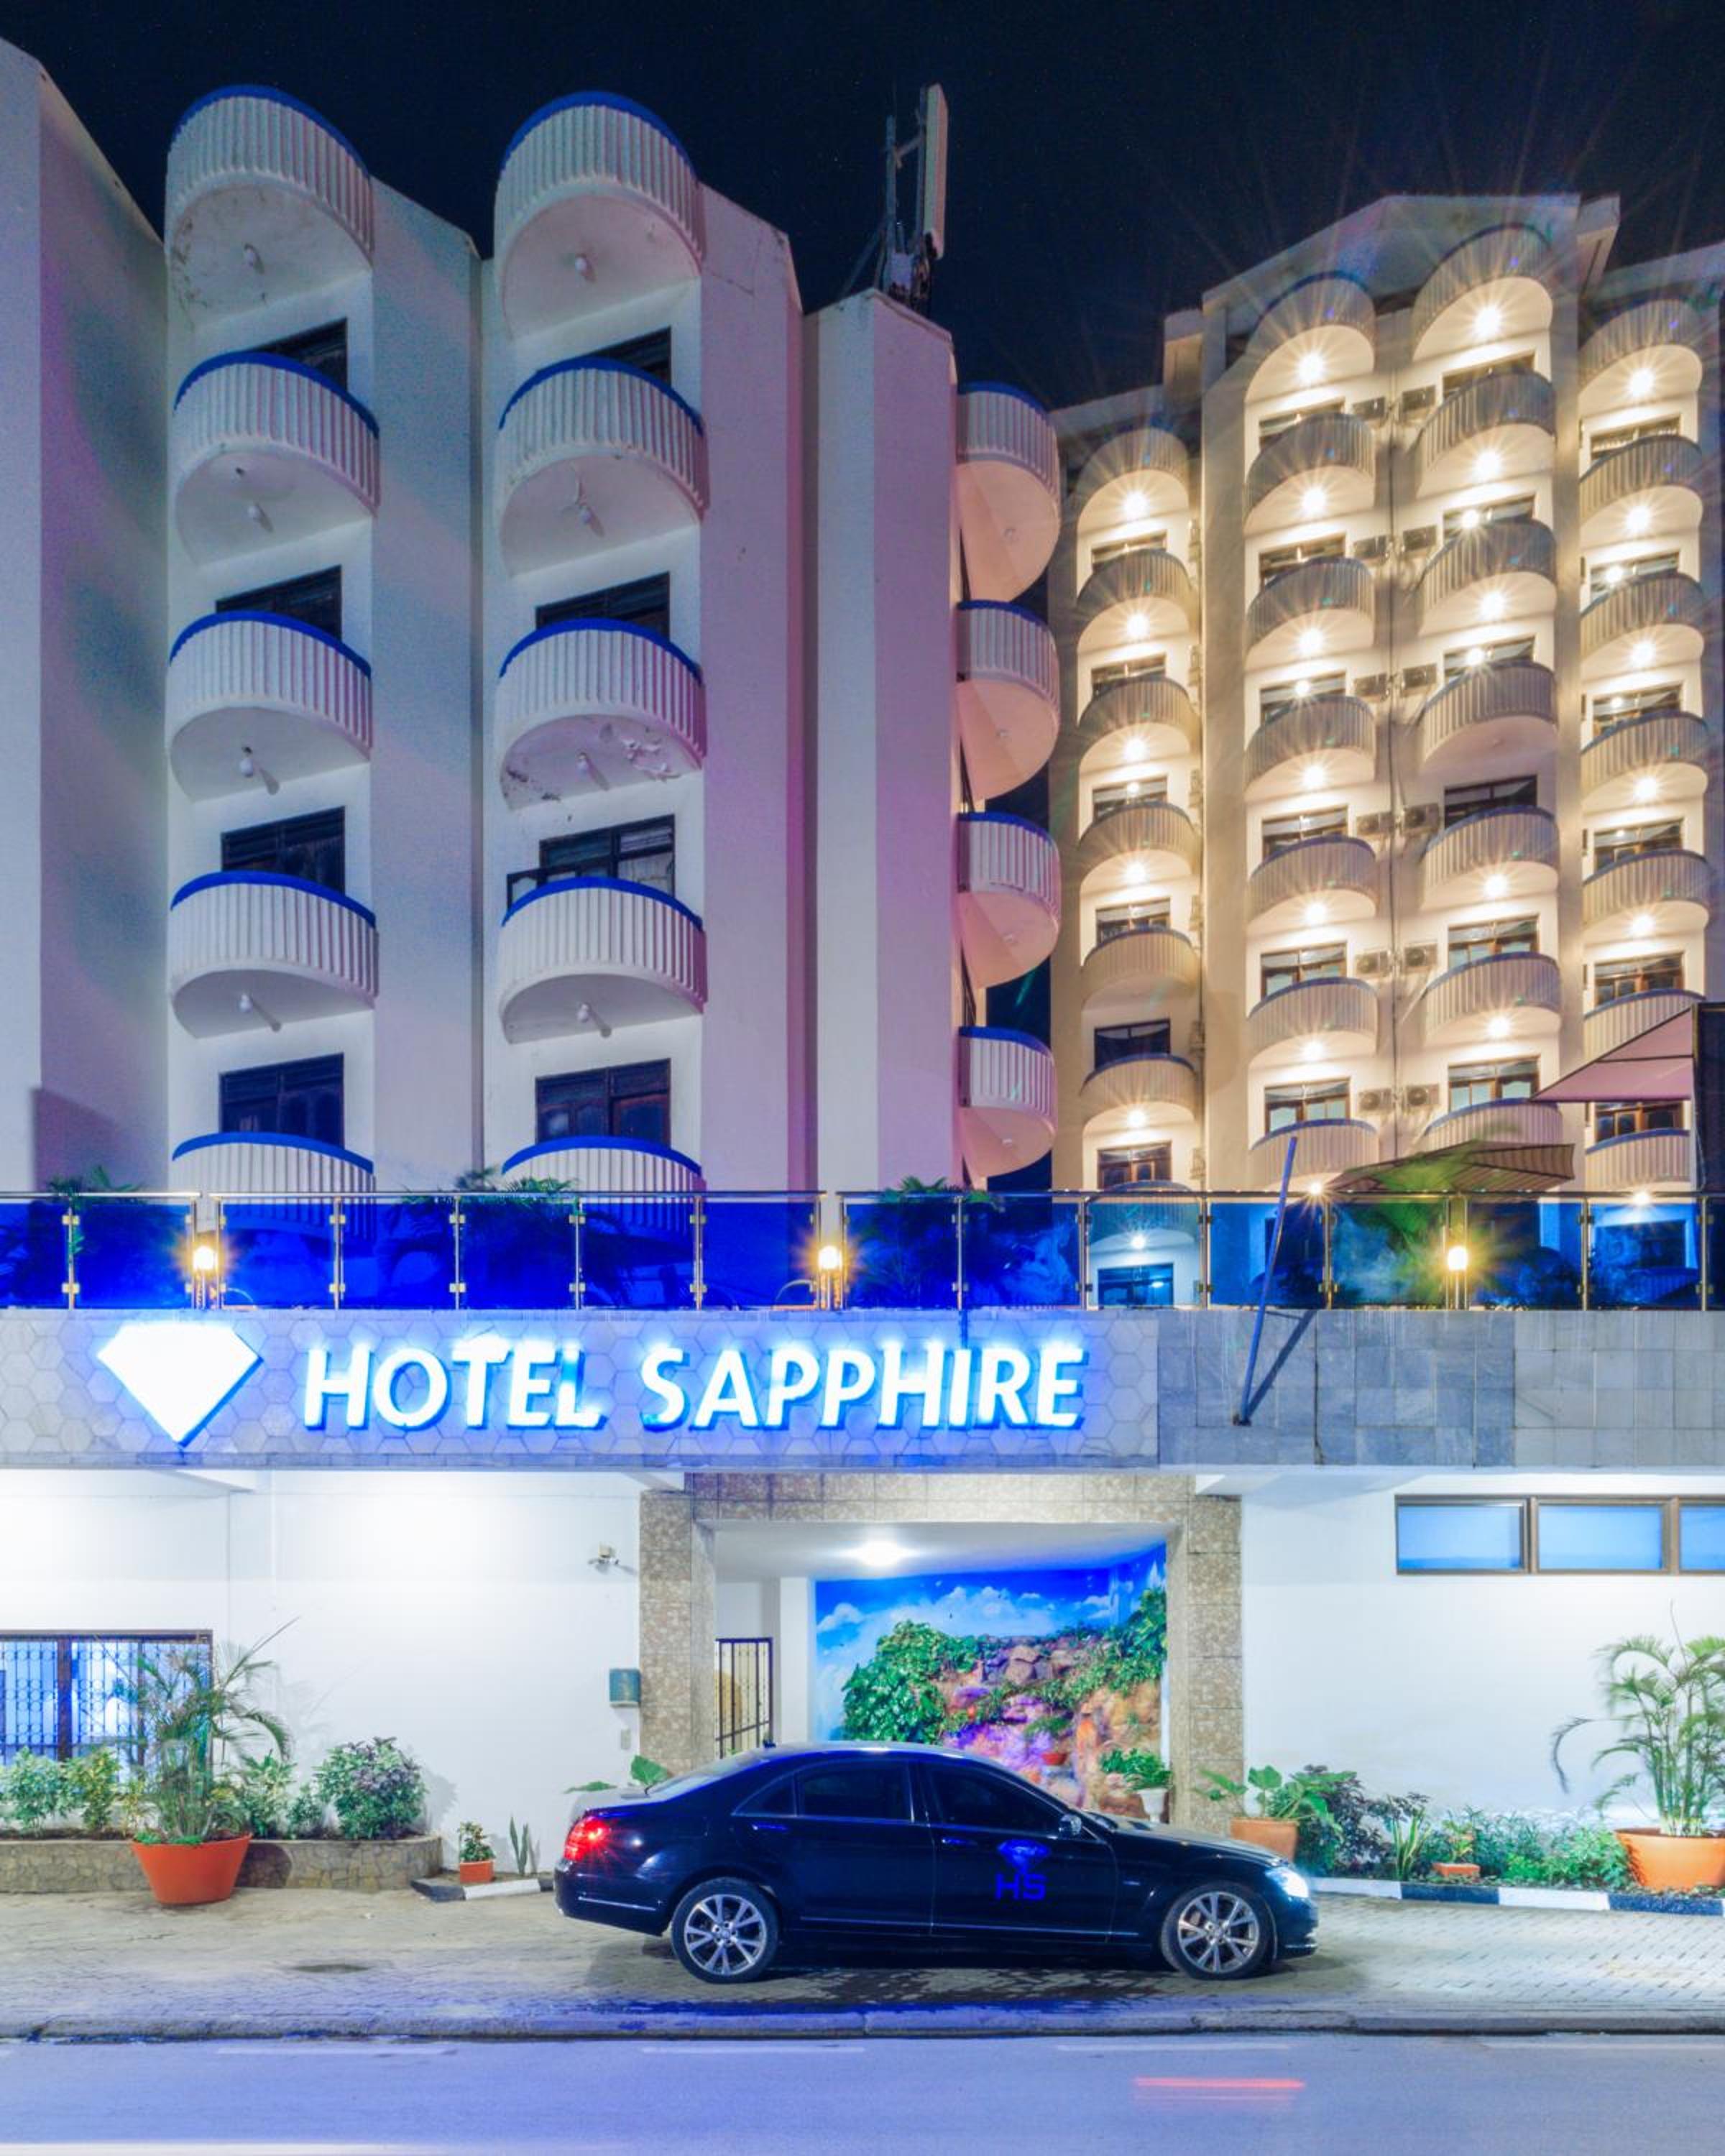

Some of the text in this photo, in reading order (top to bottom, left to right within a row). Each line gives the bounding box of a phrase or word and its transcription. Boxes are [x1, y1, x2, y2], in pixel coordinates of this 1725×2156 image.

[303, 1342, 1087, 1431] HOTEL SAPPHIRE
[995, 1872, 1046, 1900] HS
